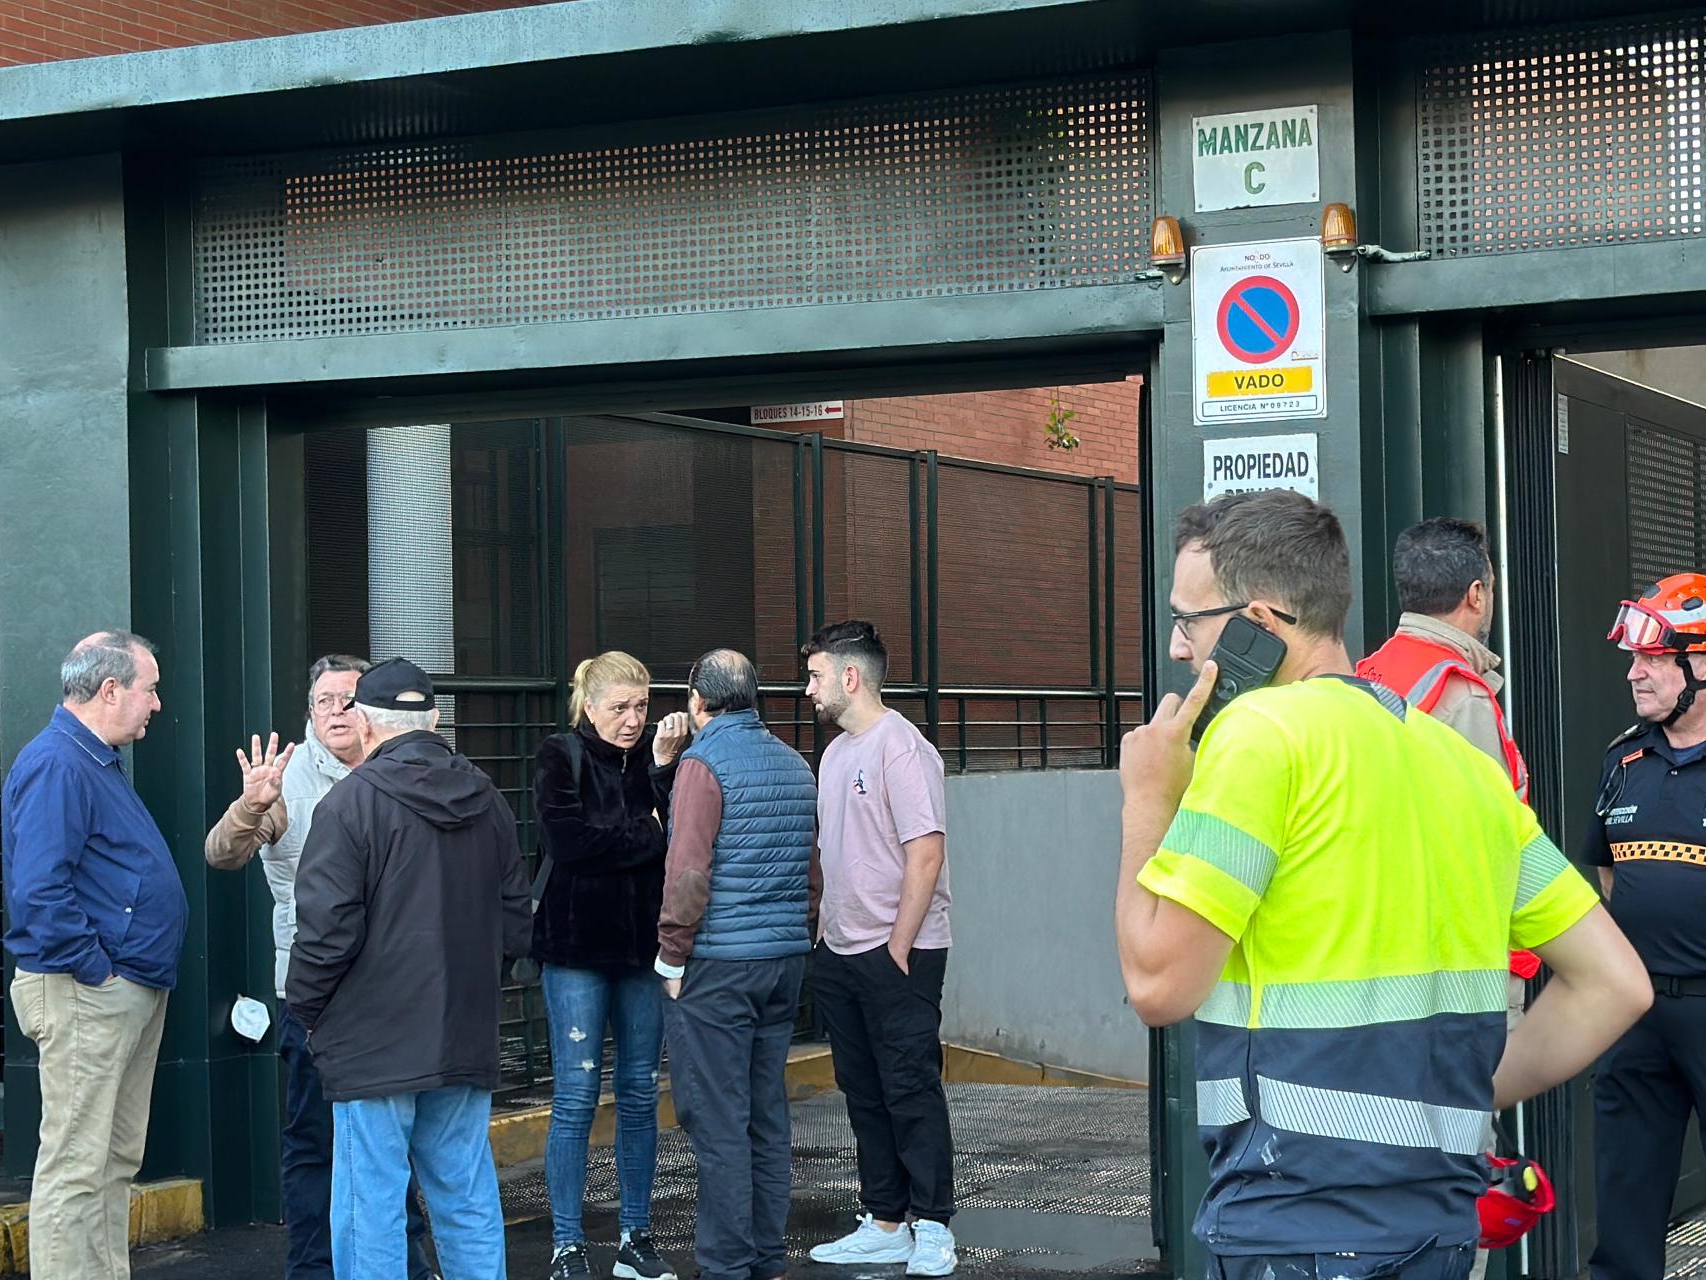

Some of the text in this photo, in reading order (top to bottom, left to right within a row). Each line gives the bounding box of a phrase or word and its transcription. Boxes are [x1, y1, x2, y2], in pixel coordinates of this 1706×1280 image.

[1198, 118, 1313, 157] MANZANA
[1244, 161, 1266, 195] C
[1234, 373, 1285, 390] VADO
[754, 404, 823, 420] BLOQUES 14-15-16
[1220, 403, 1257, 412] LICENCIA
[1213, 451, 1309, 481] PROPIEDAD
